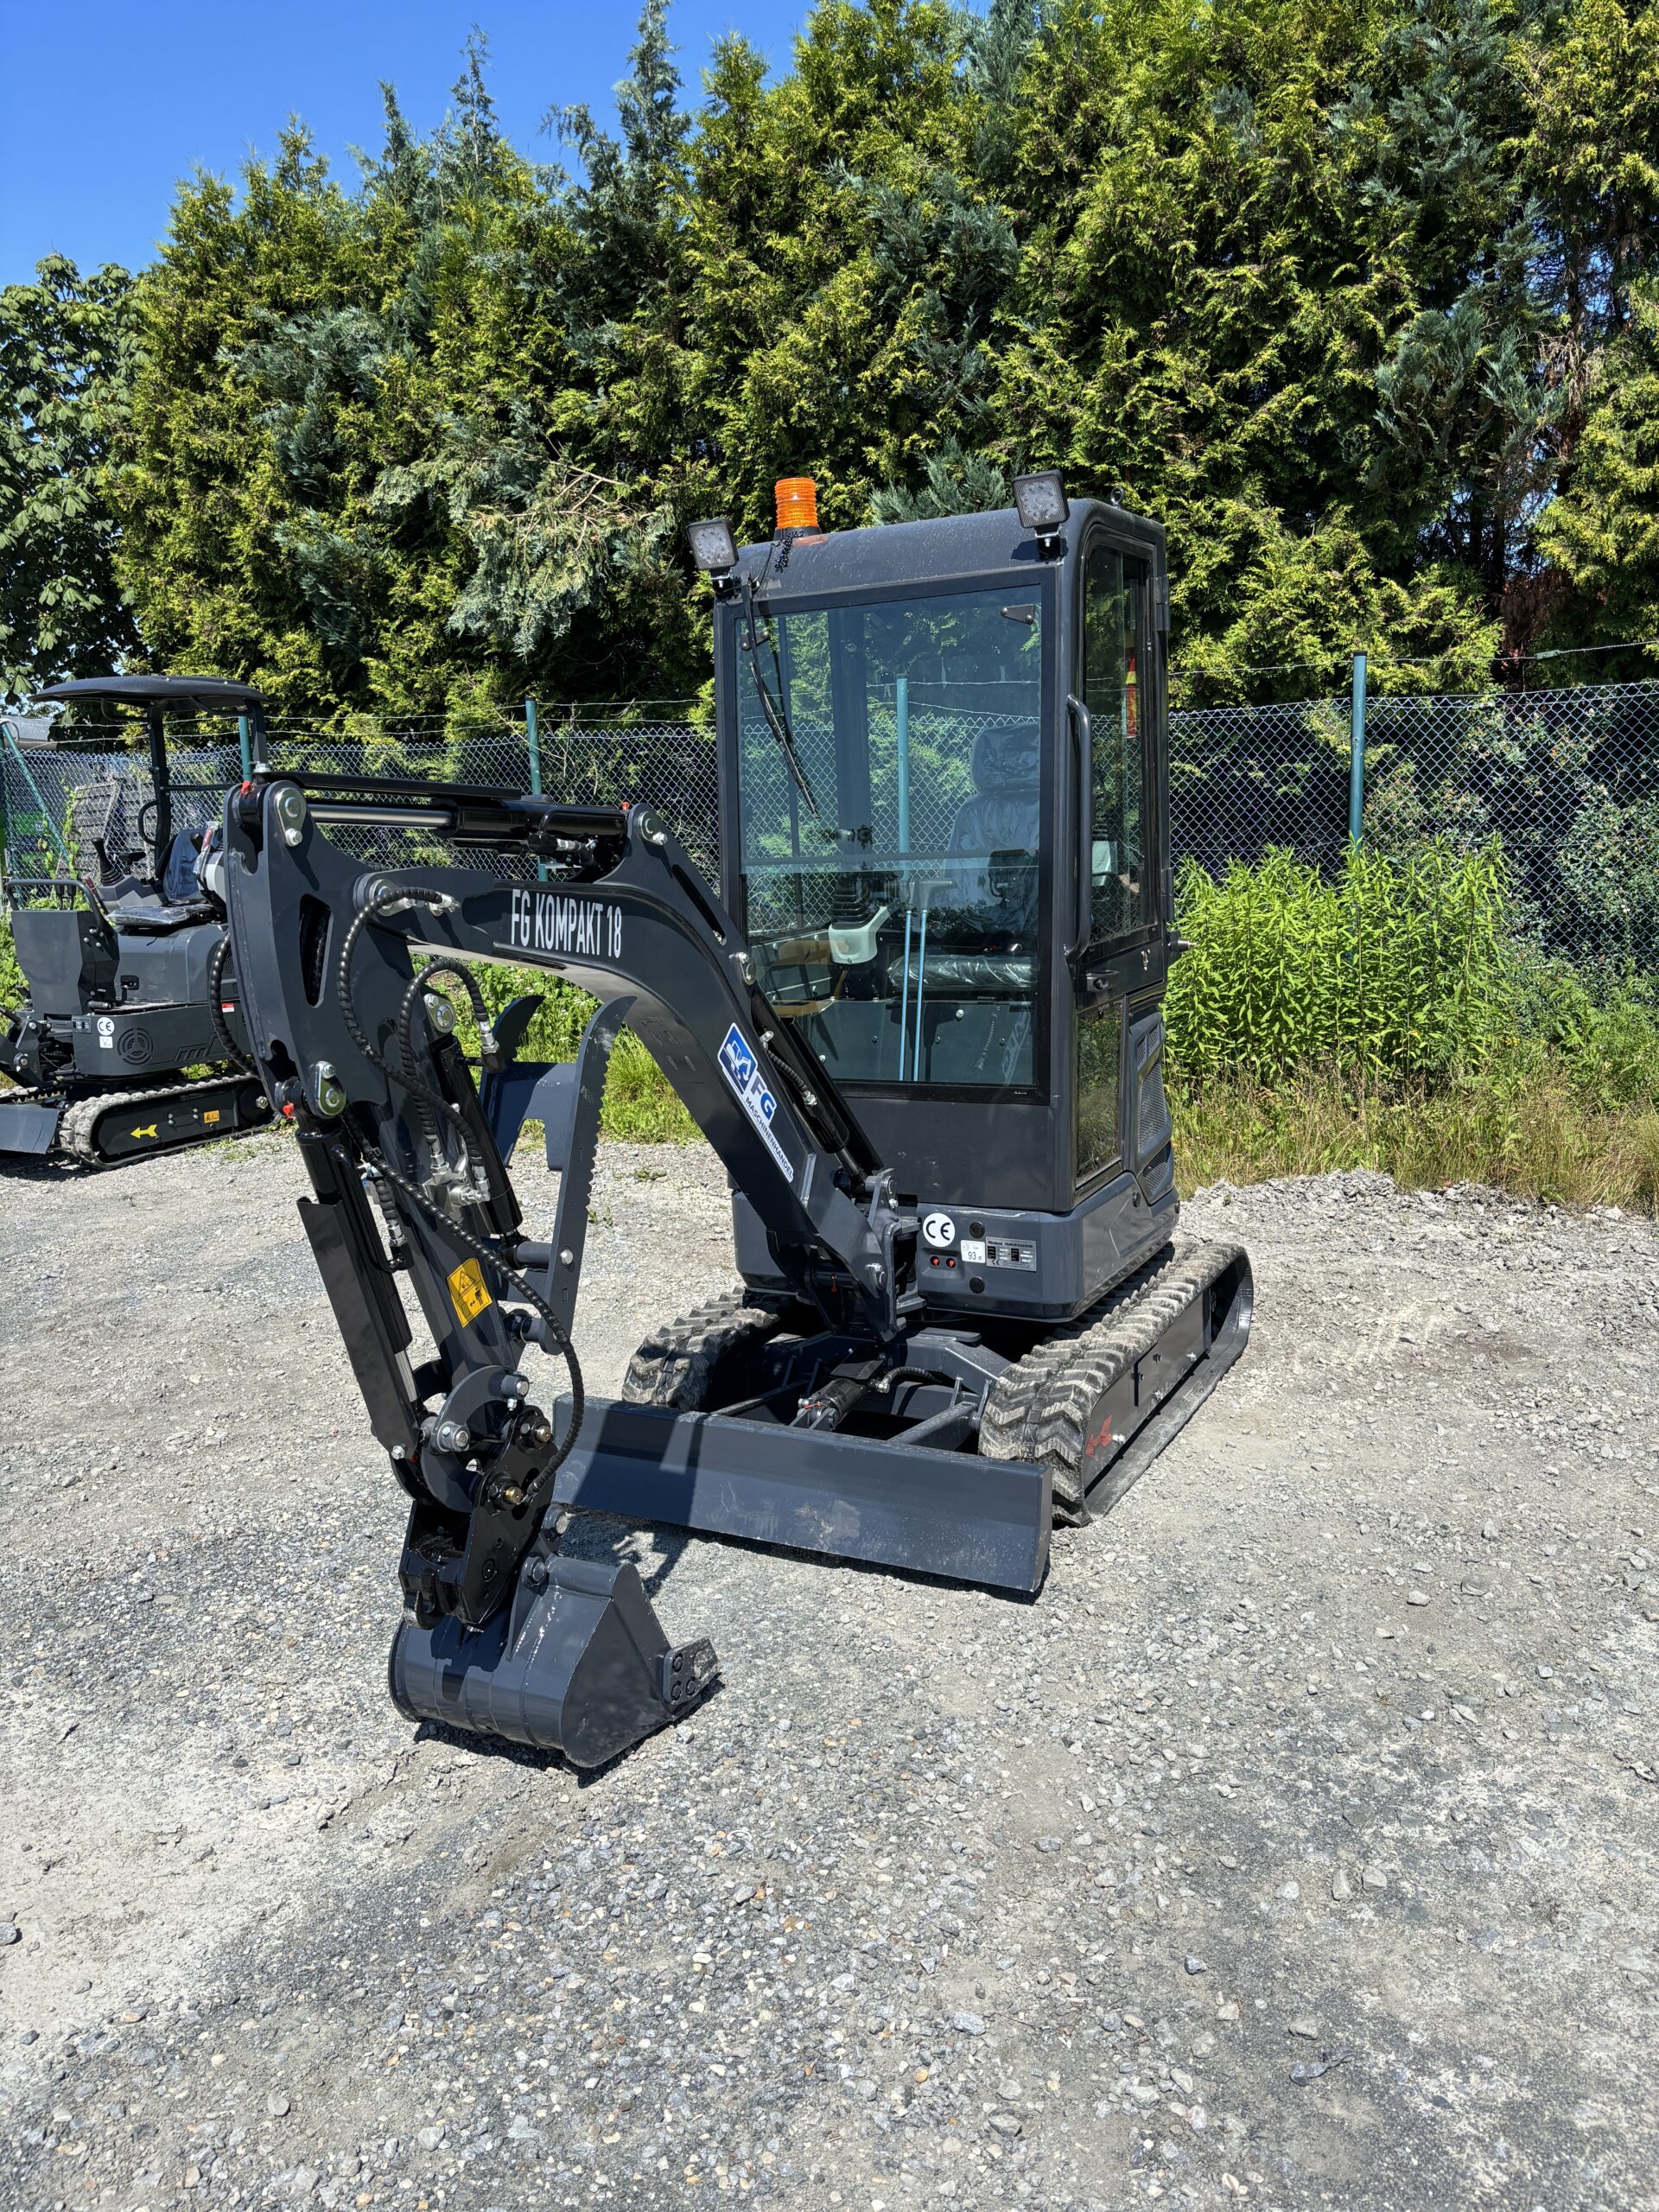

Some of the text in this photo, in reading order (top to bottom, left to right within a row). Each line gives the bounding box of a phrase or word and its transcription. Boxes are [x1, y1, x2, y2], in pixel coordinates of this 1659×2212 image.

[511, 888, 622, 959] FG KOMPAKT 18
[750, 1074, 775, 1121] FG
[745, 1096, 794, 1179] MASCHINENHANDEL
[968, 1250, 976, 1261] 93
